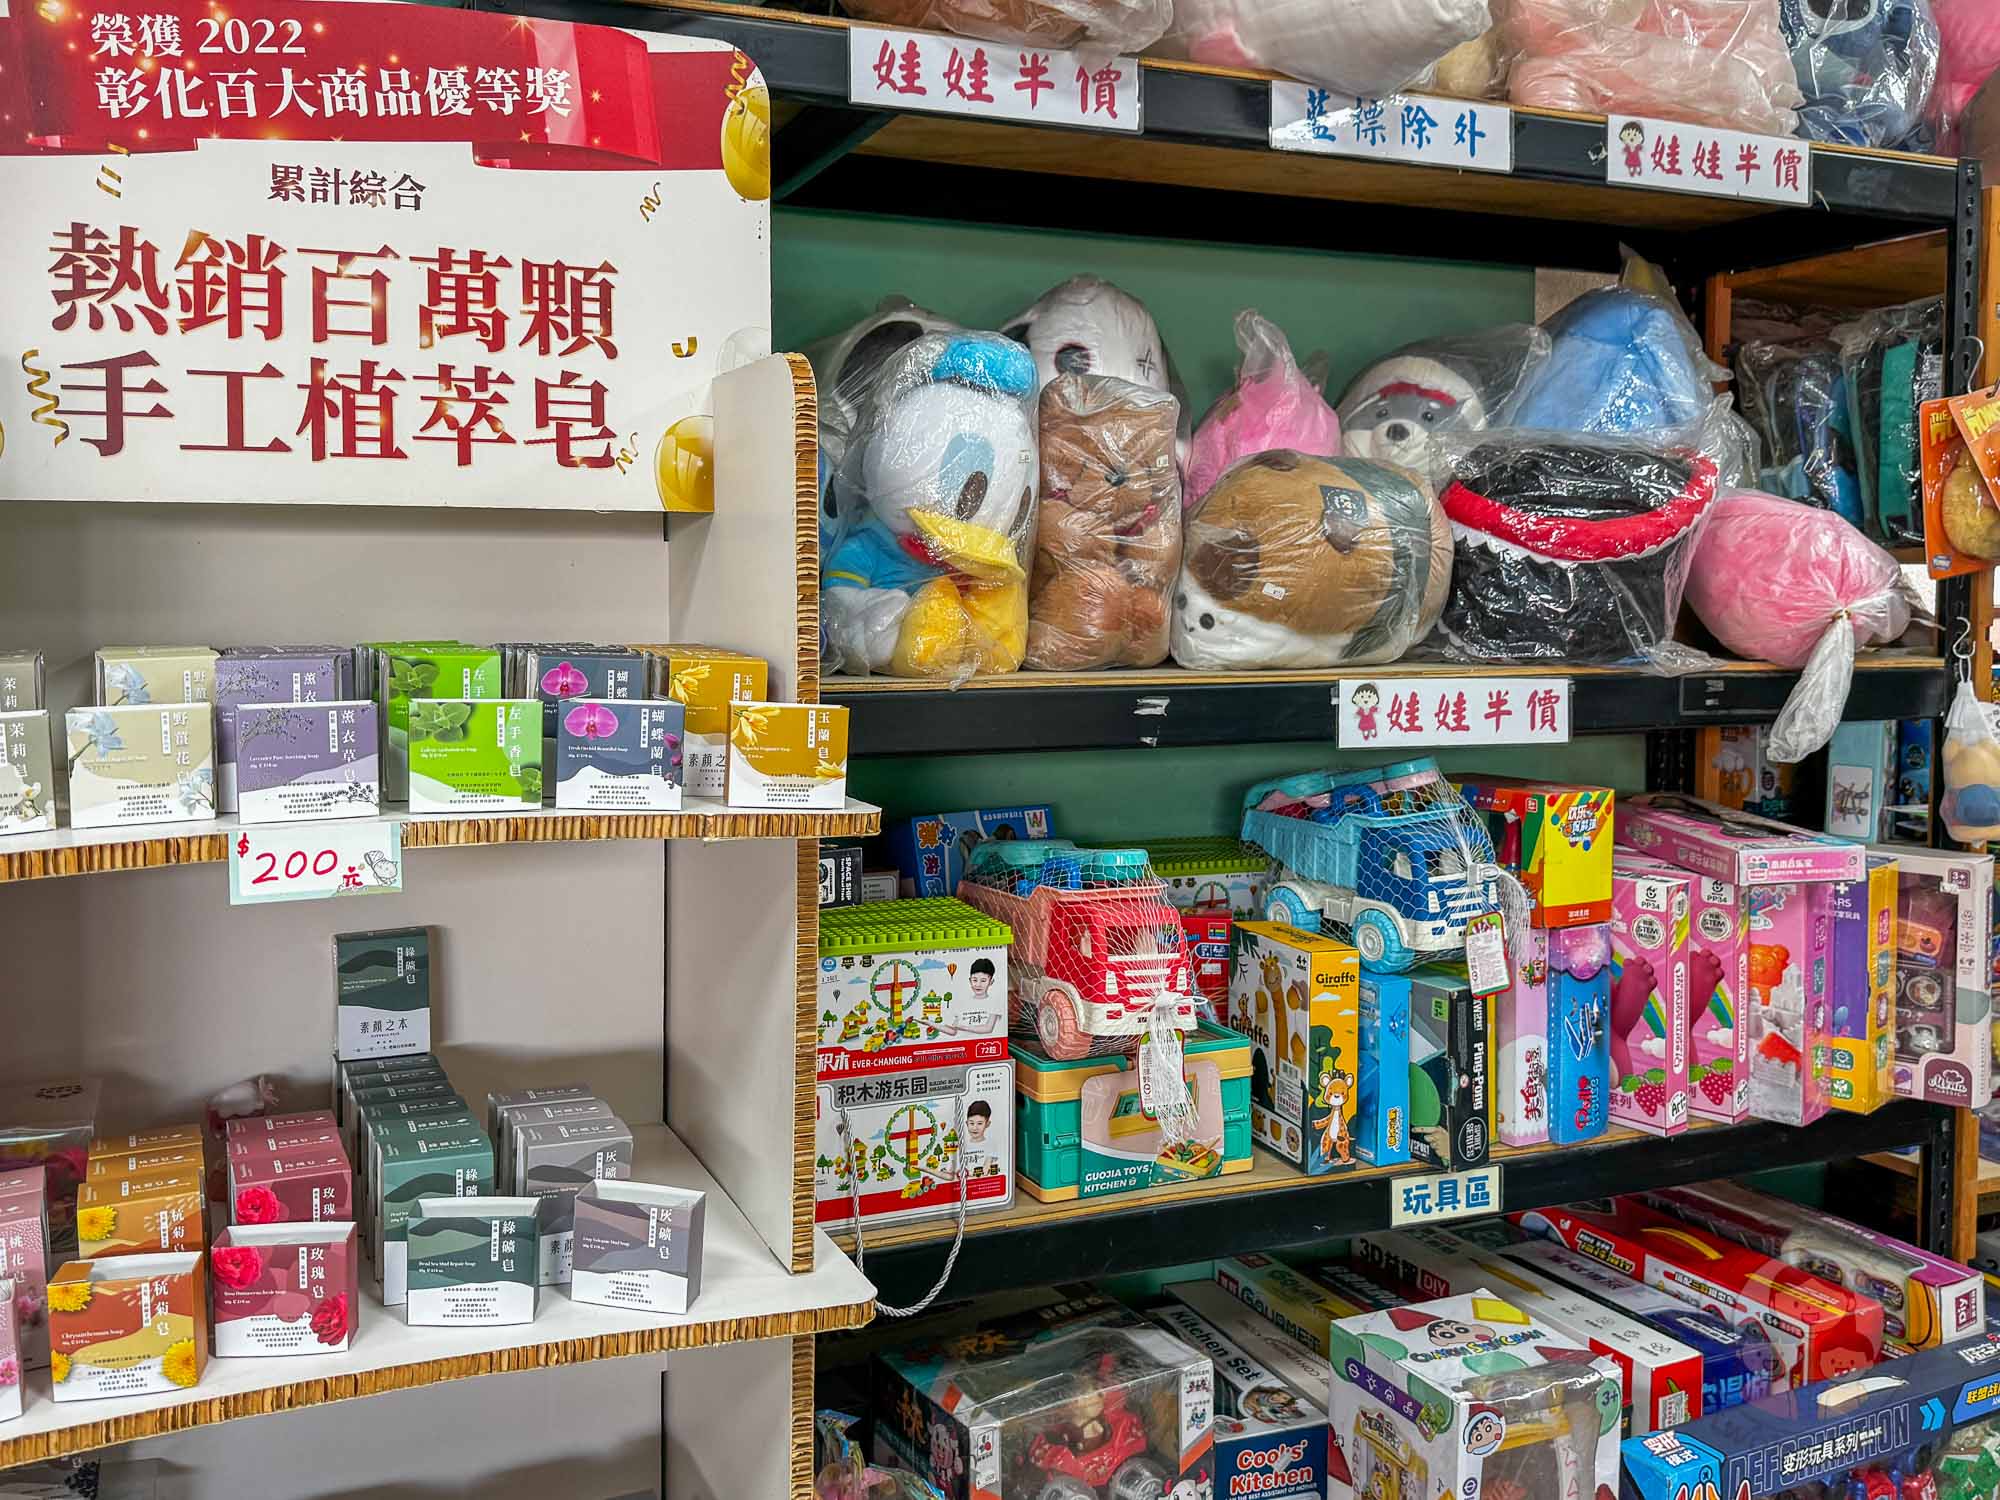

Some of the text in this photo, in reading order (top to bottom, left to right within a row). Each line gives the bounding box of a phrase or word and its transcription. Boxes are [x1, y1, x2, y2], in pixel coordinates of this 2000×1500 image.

[90, 13, 306, 58] 榮獲 2022
[96, 65, 573, 121] 彰化百大商品優等獎
[872, 38, 1122, 120] 娃娃半價
[1650, 134, 1803, 193] 娃娃半價
[268, 163, 426, 212] 累計綜合
[47, 220, 620, 361] 熱銷百萬顆
[54, 349, 617, 470] 手工植萃皂
[1385, 688, 1561, 735] 娃娃半價
[1637, 925, 1659, 936] STEM
[1703, 918, 1726, 929] STEM
[1315, 971, 1357, 985] Giraffe
[1230, 1014, 1270, 1047] Giraffe
[851, 1055, 913, 1069] EVER-CHANGING
[1473, 1042, 1484, 1110] Ping-Pong
[837, 1076, 928, 1105] 积木游乐园
[1084, 1178, 1127, 1193] KITCHEN
[1085, 1164, 1149, 1182] GUOJIA TOYS
[322, 1186, 336, 1222] 玫瑰
[1403, 1175, 1490, 1216] 玩具區
[310, 1247, 325, 1300] 玫瑰皂
[1170, 1309, 1264, 1381] Kitchen Set
[1600, 1389, 1619, 1406] 3+
[1967, 1382, 2000, 1406] 联盟战
[1782, 1429, 1860, 1476] 变形玩具系列
[1230, 1466, 1313, 1496] Kitchen
